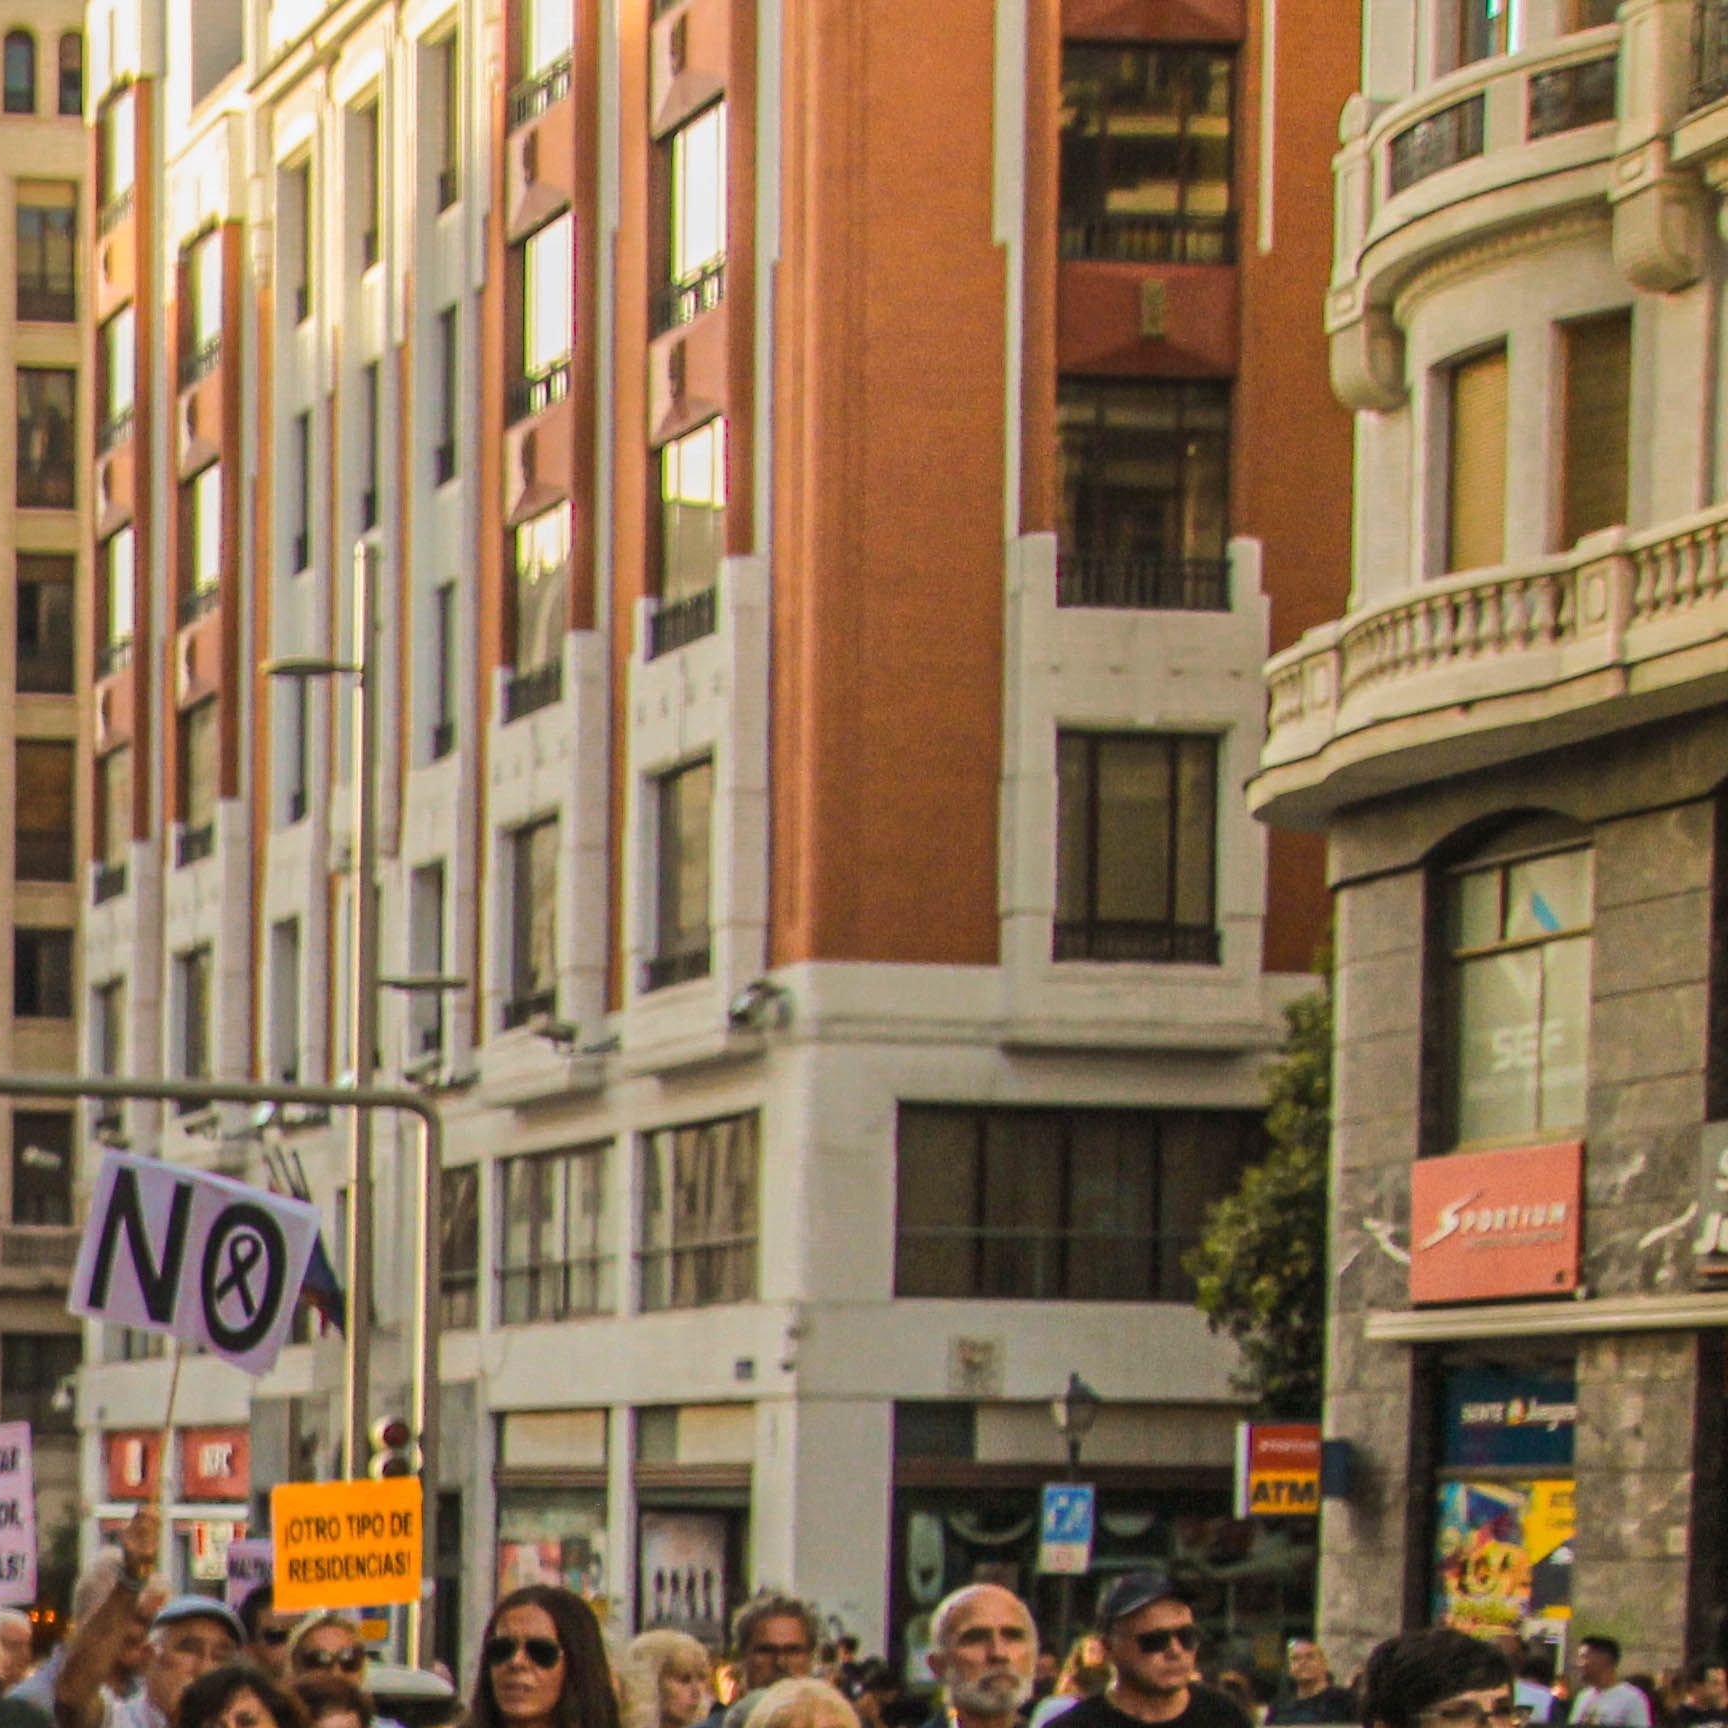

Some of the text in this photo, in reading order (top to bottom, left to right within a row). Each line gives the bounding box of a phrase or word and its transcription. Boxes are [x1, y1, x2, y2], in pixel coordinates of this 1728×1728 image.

[87, 1166, 287, 1356] NO
[1252, 1478, 1319, 1507] ATM
[346, 1513, 386, 1540] TIPO
[390, 1511, 414, 1538] DE
[288, 1553, 412, 1584] RESIDENCIAS!
